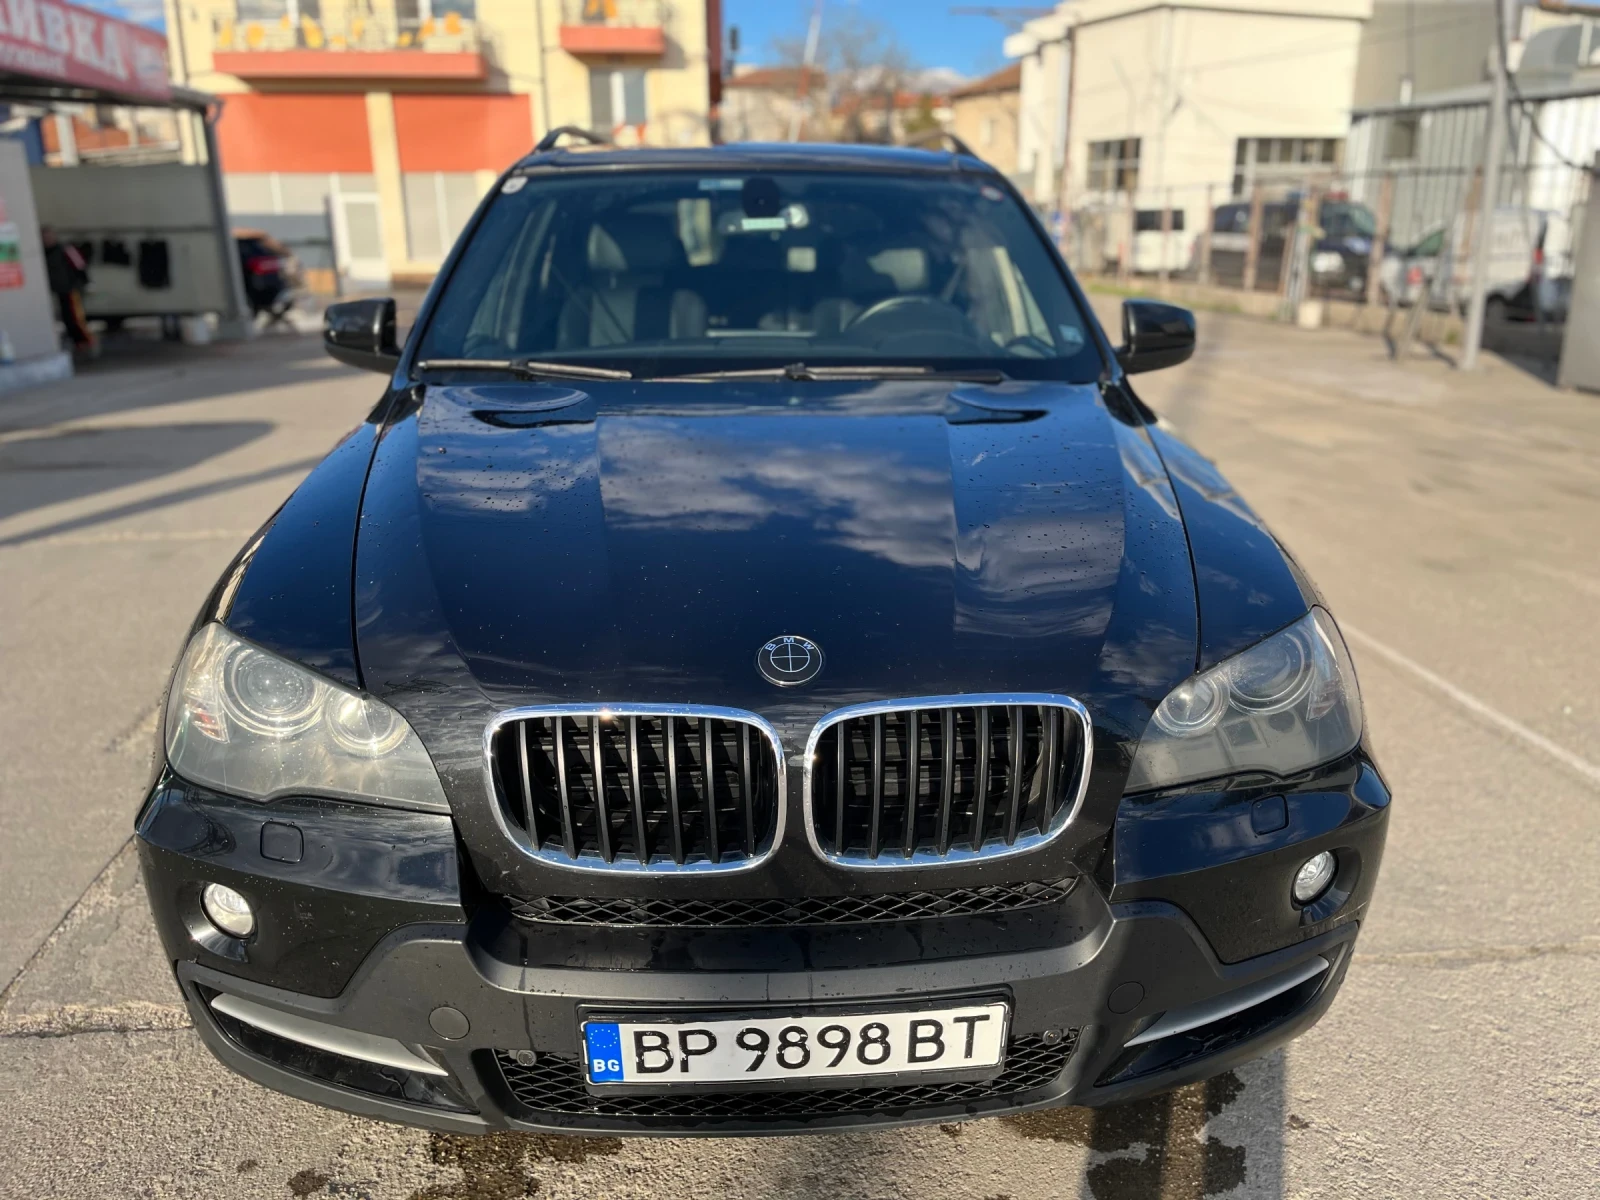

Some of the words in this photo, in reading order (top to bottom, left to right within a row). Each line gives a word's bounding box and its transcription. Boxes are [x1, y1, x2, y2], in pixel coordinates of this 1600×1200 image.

[0, 0, 130, 82] ИВКА
[764, 637, 815, 651] BMW
[633, 1028, 718, 1074] BP
[735, 1022, 892, 1072] 9898
[907, 1014, 991, 1064] BT
[593, 1058, 620, 1073] BG
